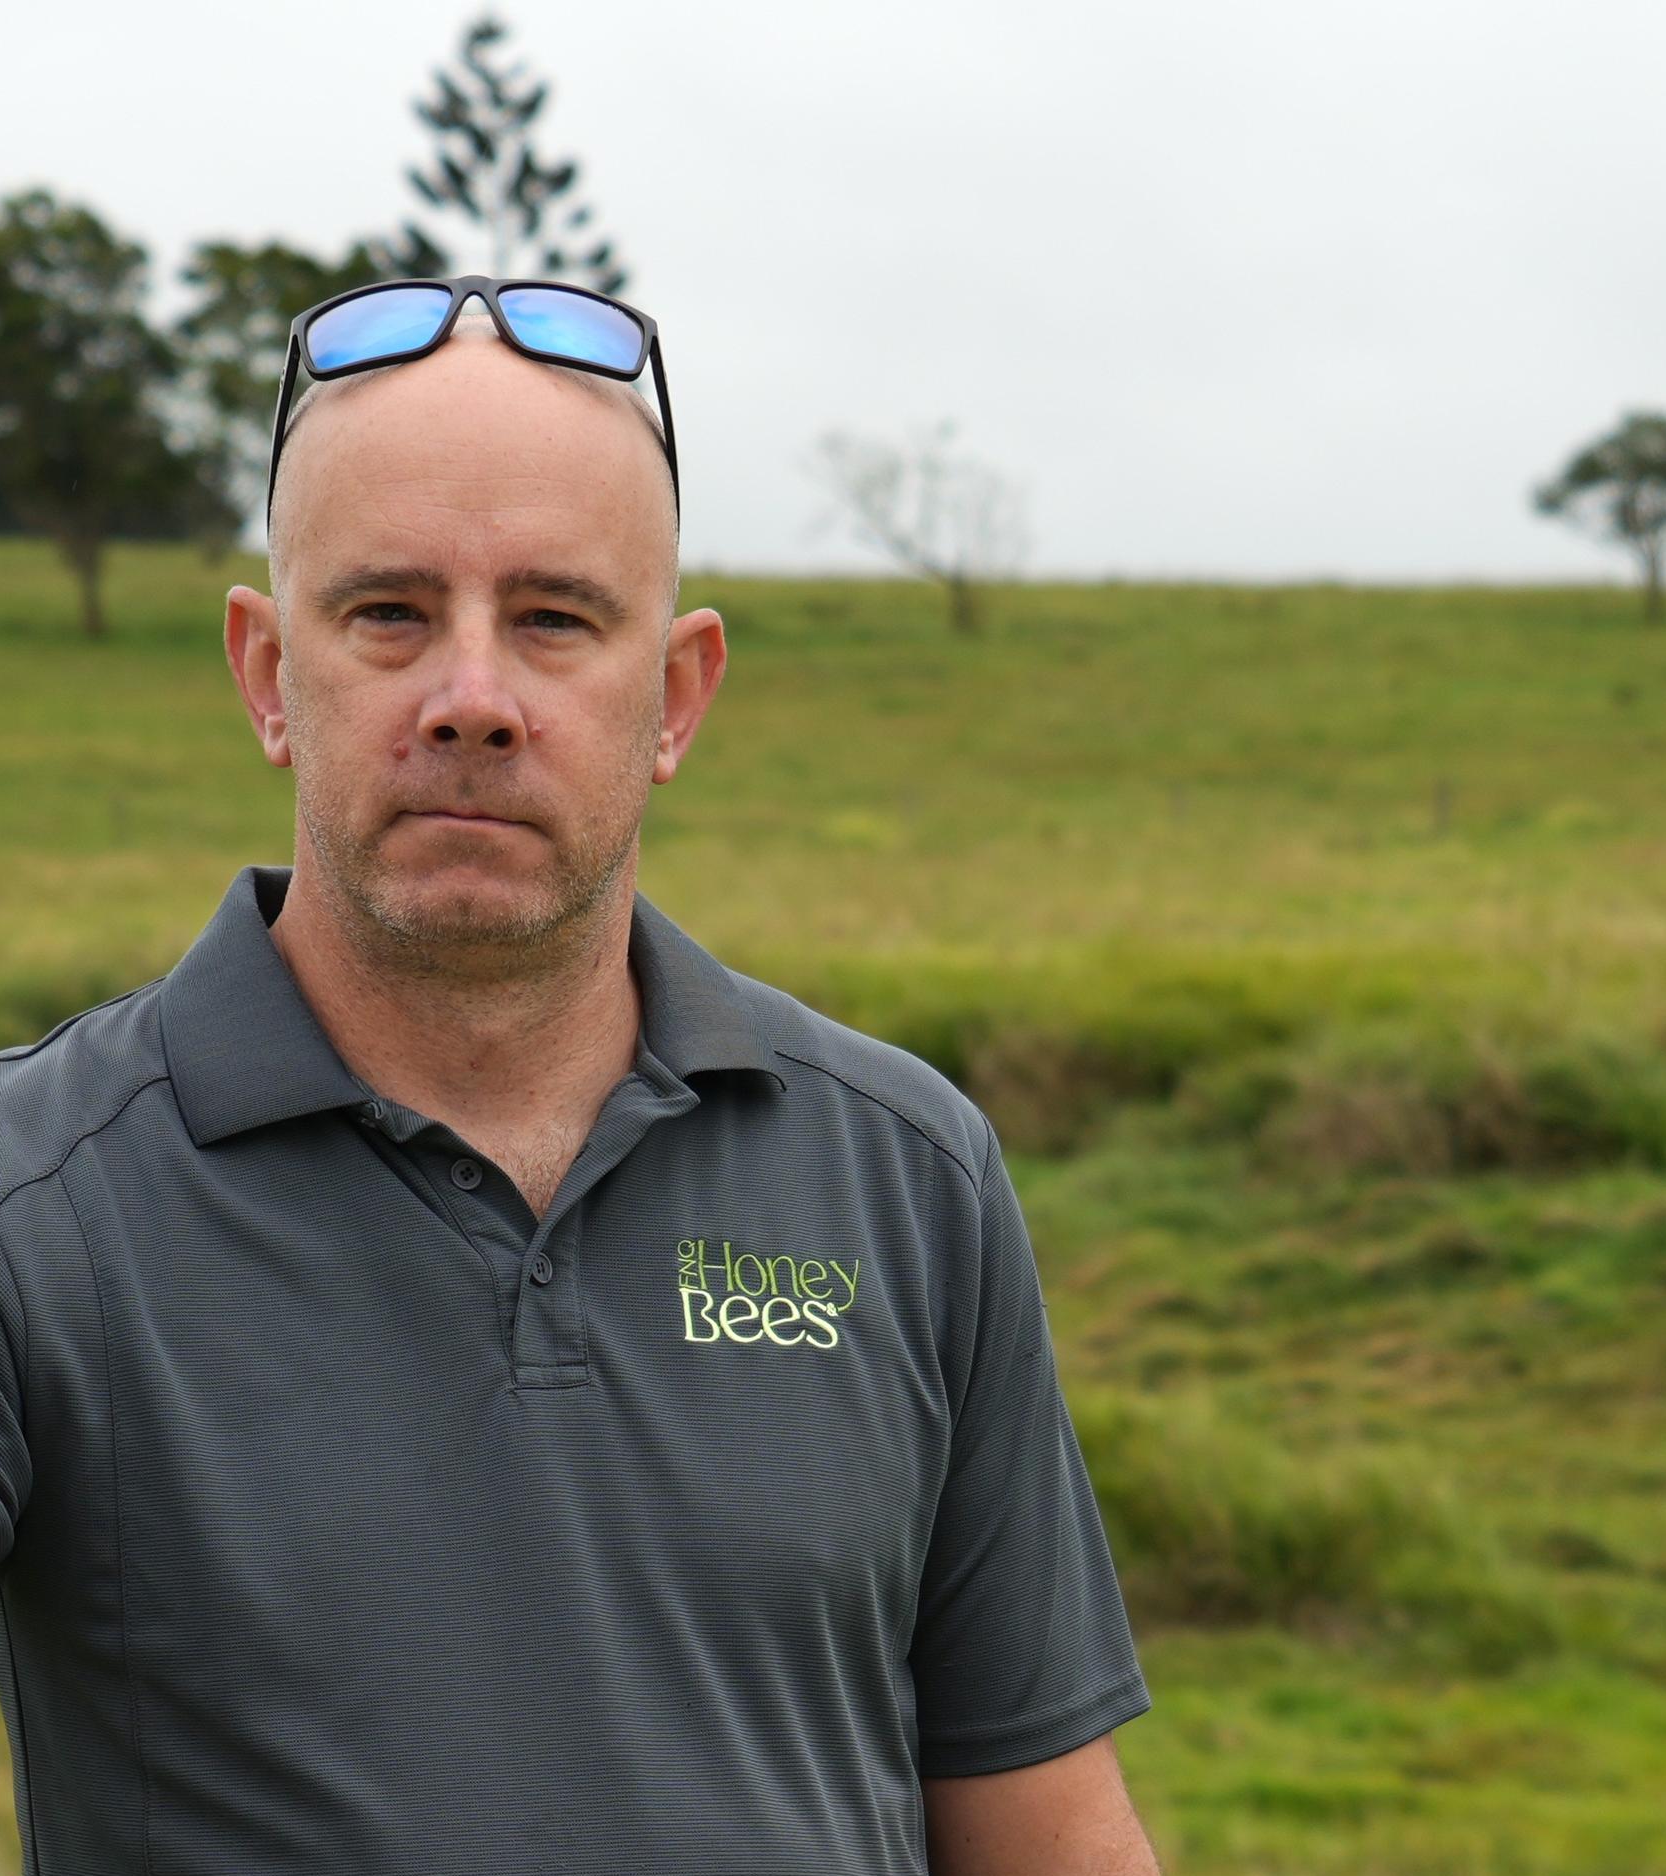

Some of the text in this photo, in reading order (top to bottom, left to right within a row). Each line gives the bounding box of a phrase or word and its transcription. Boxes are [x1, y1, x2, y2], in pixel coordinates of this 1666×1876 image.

[677, 1239, 699, 1290] FNQ
[697, 1239, 860, 1312] Honey
[679, 1287, 839, 1349] Bees
